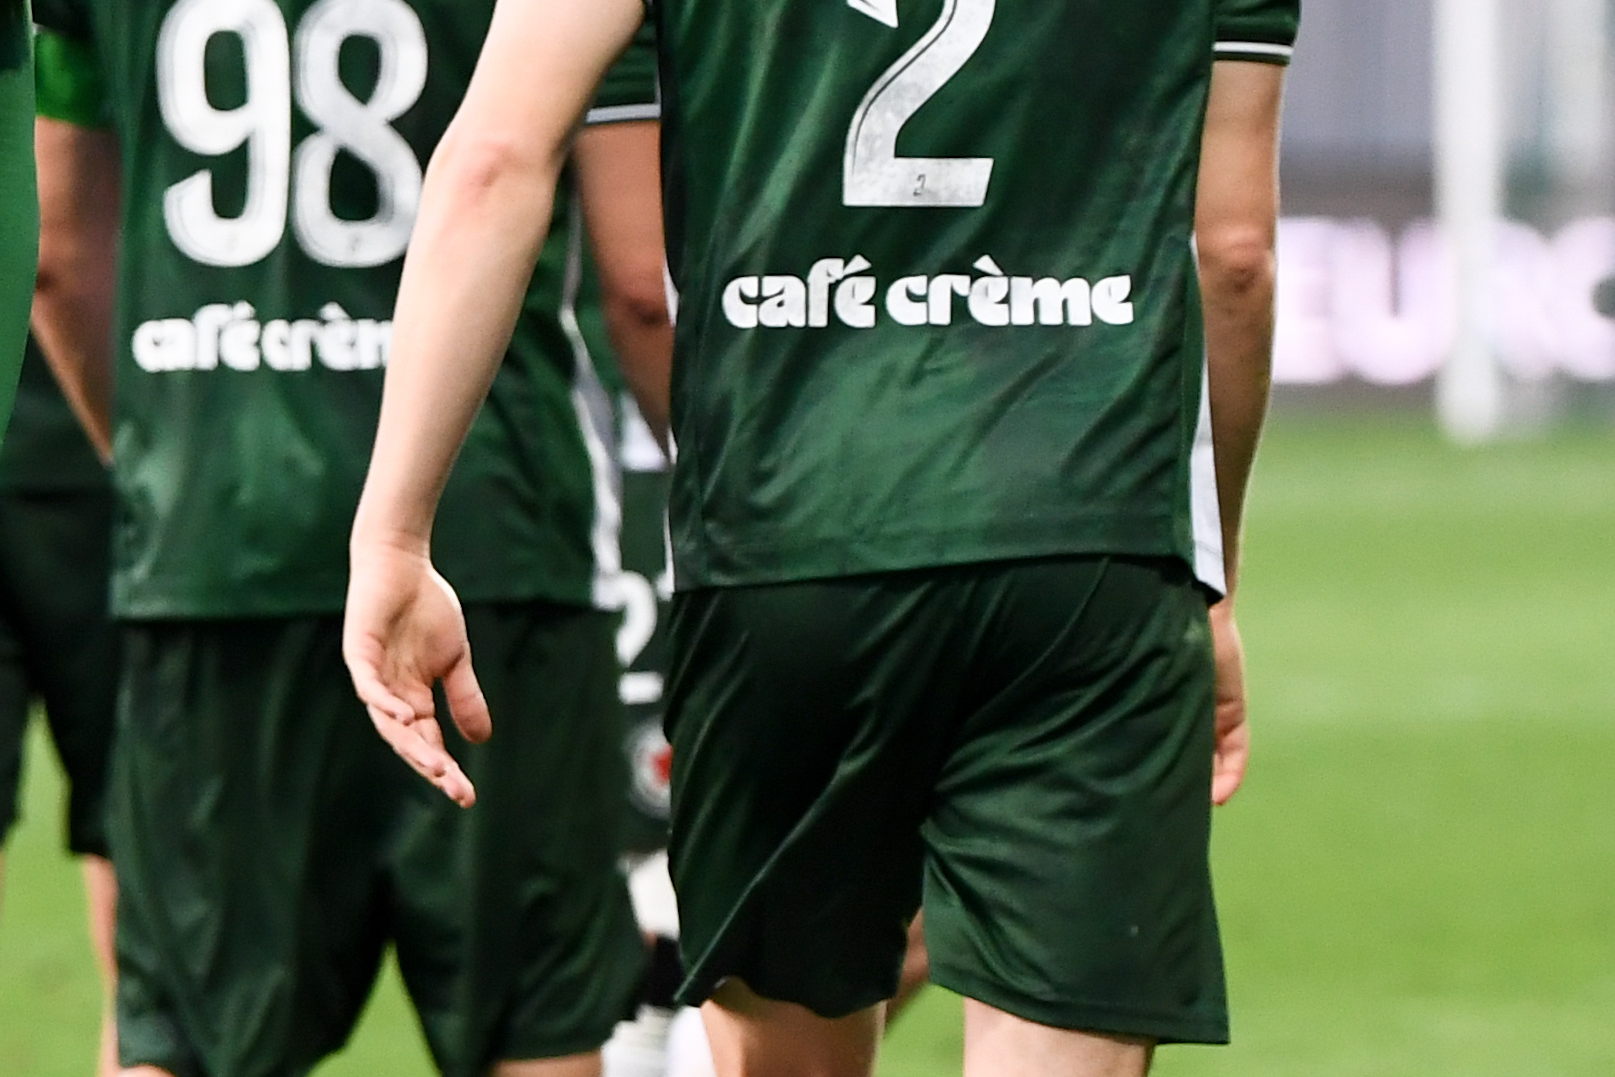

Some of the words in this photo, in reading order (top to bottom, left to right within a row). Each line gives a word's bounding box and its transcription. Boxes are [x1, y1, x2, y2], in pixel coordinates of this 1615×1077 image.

[721, 254, 876, 329] café
[885, 254, 1134, 328] crème
[132, 299, 261, 373] café
[261, 301, 395, 372] crèm
